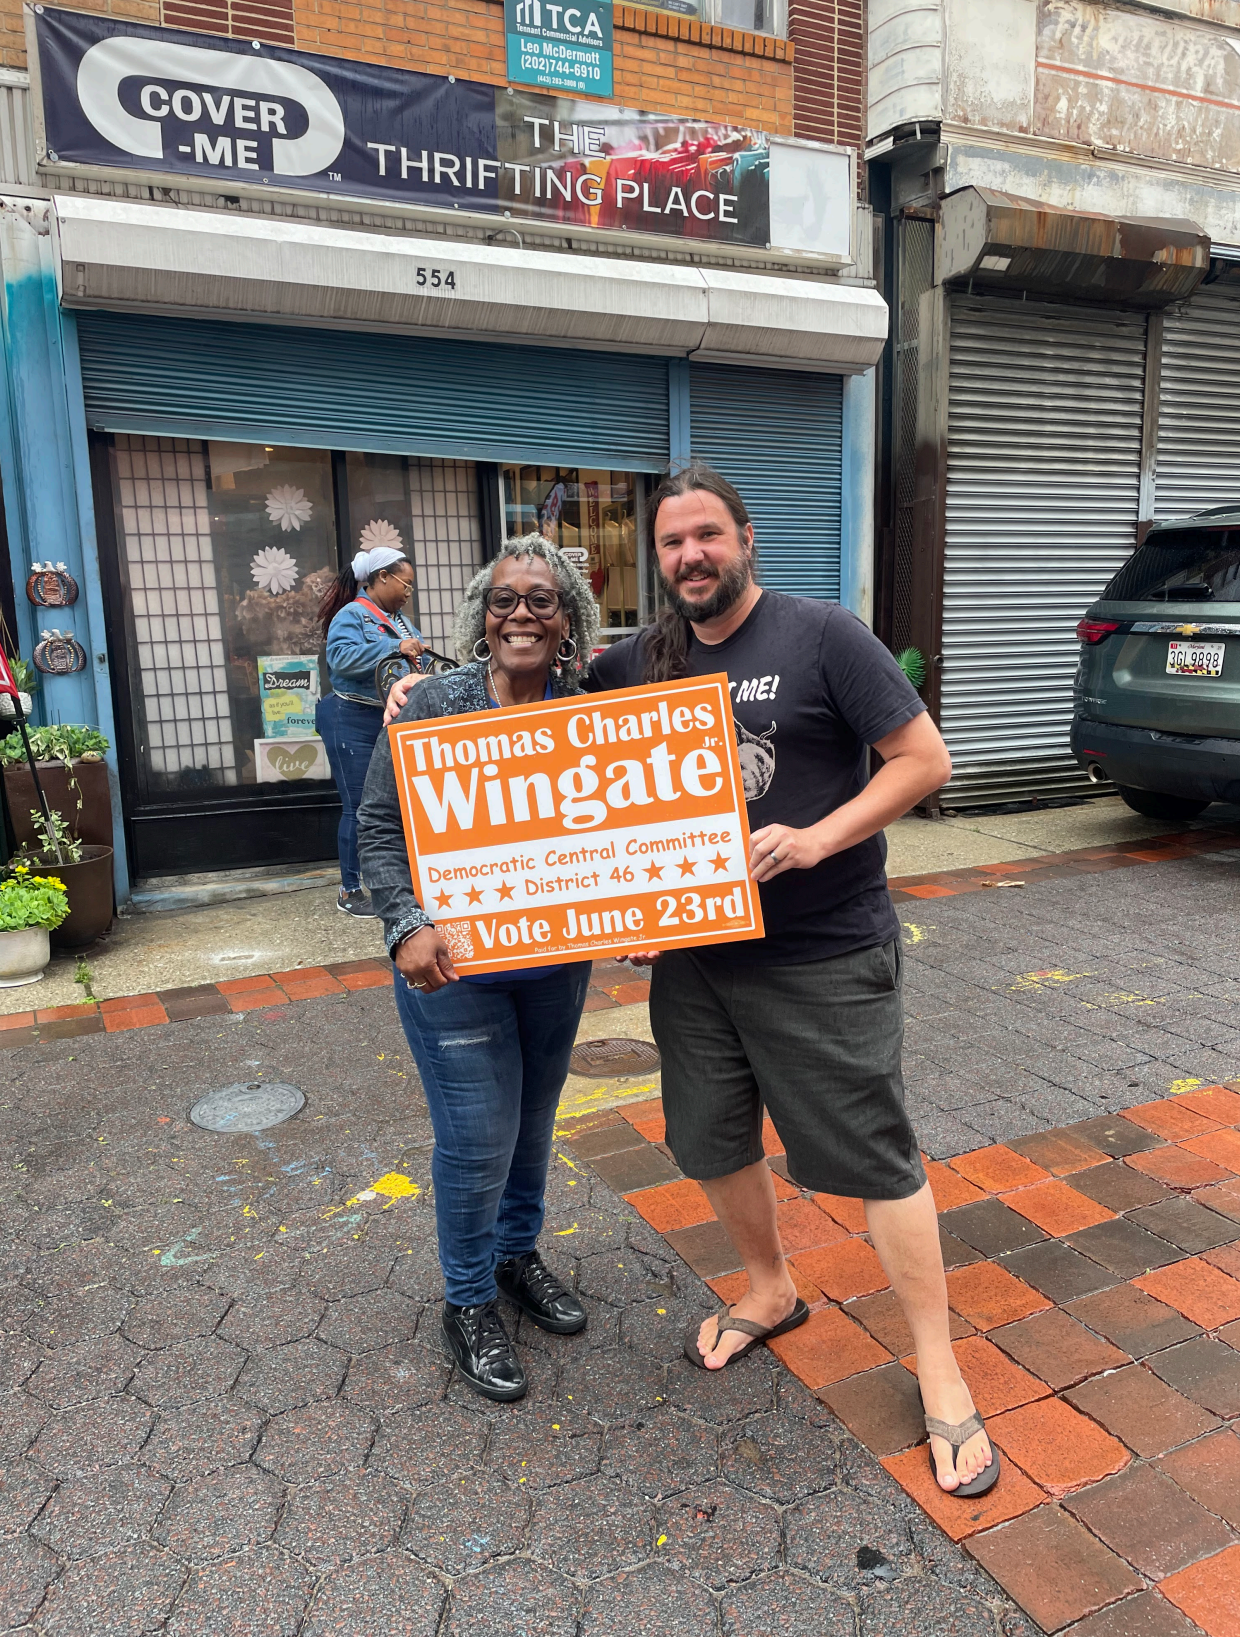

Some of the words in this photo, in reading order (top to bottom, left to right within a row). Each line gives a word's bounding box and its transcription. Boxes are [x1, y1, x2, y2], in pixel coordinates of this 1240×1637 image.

[516, 24, 541, 35] Tennant
[542, 28, 577, 42] Commercial
[579, 35, 603, 46] Advisors
[545, 3, 603, 38] TCA
[520, 38, 540, 54] Leo
[542, 42, 600, 64] McDermott
[521, 54, 600, 80] (202)744-6910
[537, 75, 551, 84] (443)
[140, 84, 288, 135] COVER
[178, 133, 260, 171] -ME
[523, 115, 606, 159] THE
[366, 141, 603, 207] THRIFTING
[615, 177, 739, 225] PLACE
[416, 267, 456, 290] 554
[587, 487, 598, 555] WELCOME
[264, 673, 310, 689] Dream
[735, 674, 780, 703] ME!
[287, 716, 315, 725] foreve
[406, 728, 555, 771] Thomas
[567, 701, 715, 748] Charles
[702, 736, 723, 748] Jr.
[275, 755, 310, 772] live
[411, 741, 723, 833] Wingate
[428, 855, 536, 883] Democratic
[544, 841, 616, 867] Central
[625, 830, 732, 856] Committee
[524, 870, 600, 896] District
[609, 865, 635, 884] 46
[475, 915, 551, 949] Vote
[562, 907, 644, 939] June
[656, 886, 745, 927] 23rd
[534, 945, 547, 953] Paid
[548, 944, 557, 952] for
[558, 944, 566, 952] by
[567, 941, 589, 949] Thomas
[590, 938, 612, 947] Charles
[613, 935, 637, 944] Wingate
[638, 933, 647, 941] Jr.
